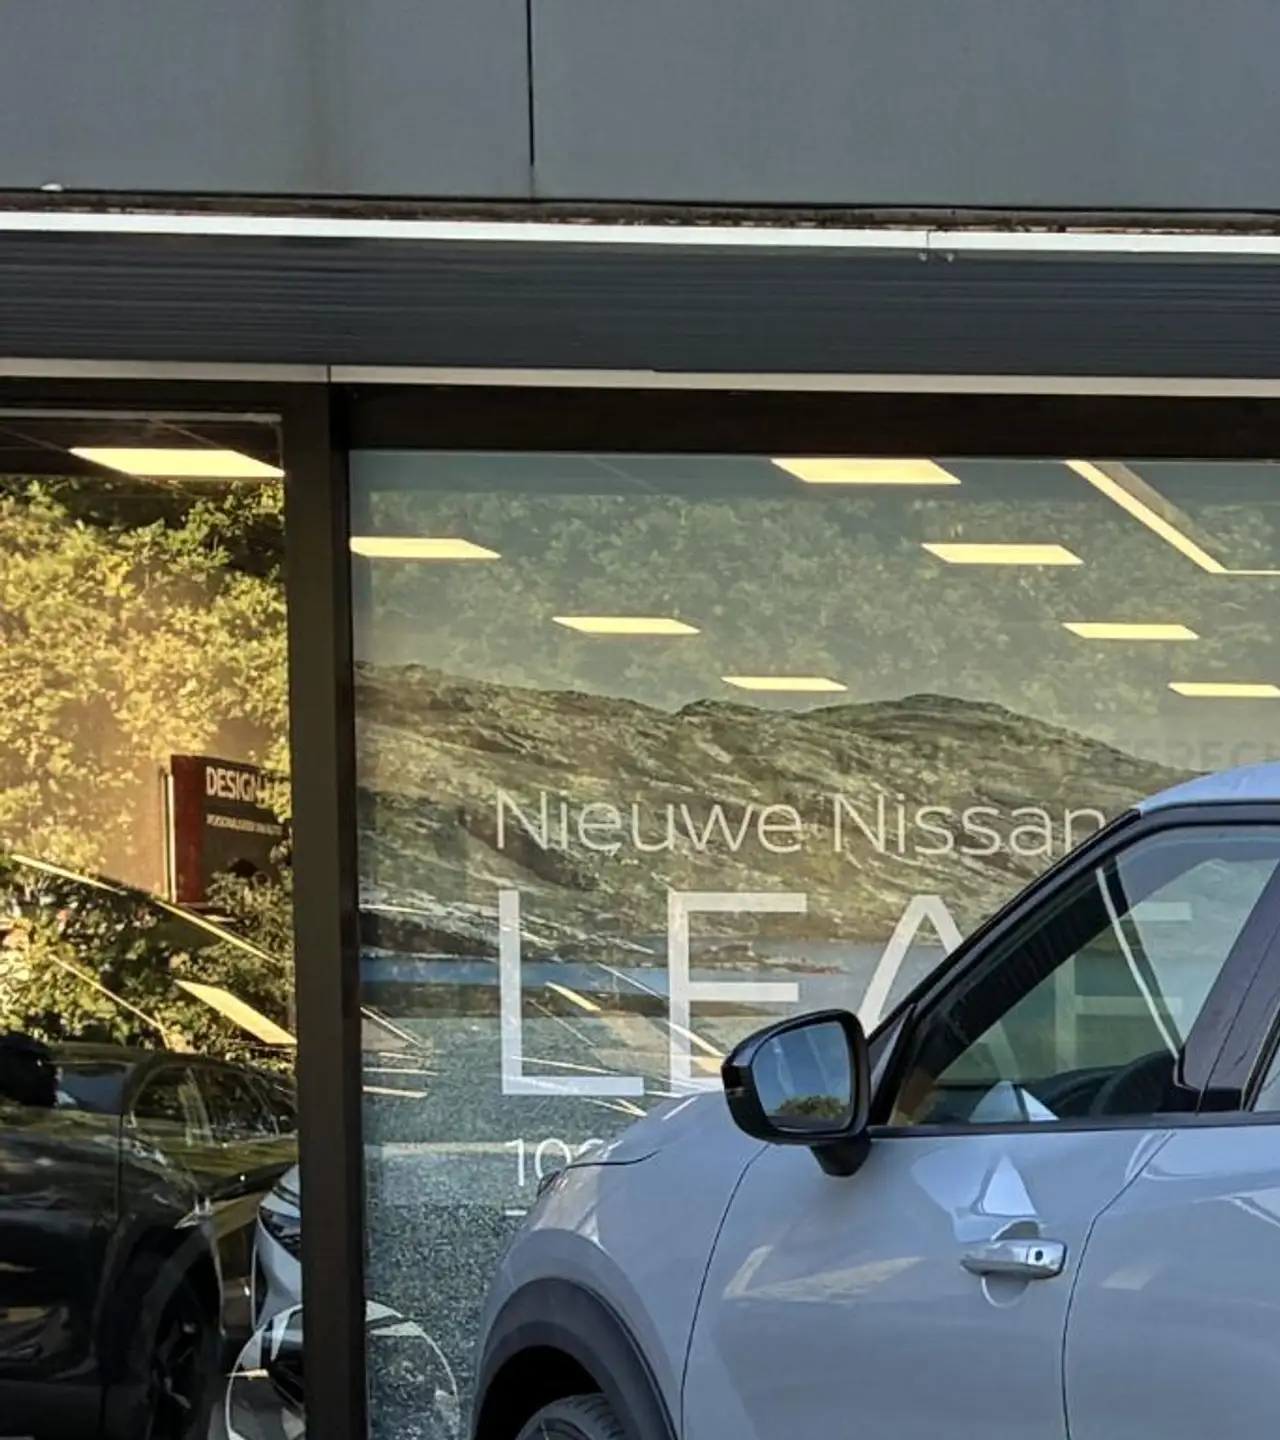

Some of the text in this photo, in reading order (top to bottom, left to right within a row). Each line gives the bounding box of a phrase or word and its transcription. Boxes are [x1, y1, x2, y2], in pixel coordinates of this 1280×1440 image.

[496, 789, 1108, 856] Nieuwe Nissan
[505, 1138, 604, 1187] 10
